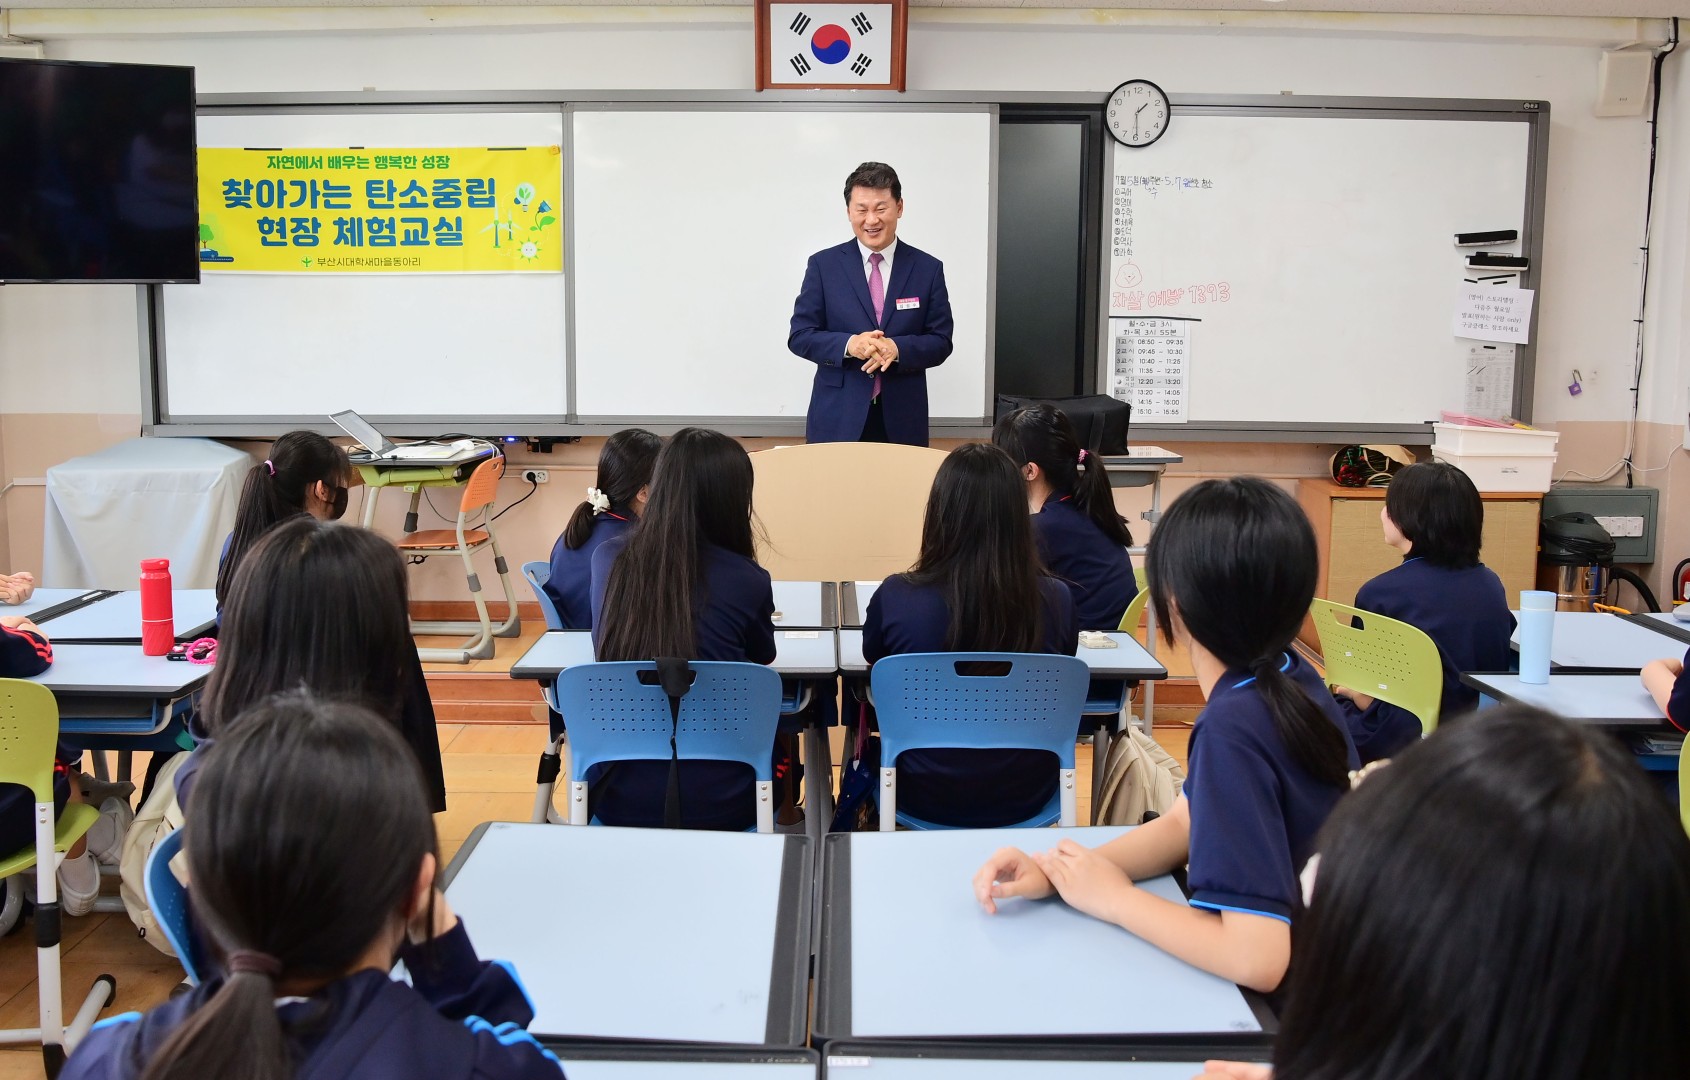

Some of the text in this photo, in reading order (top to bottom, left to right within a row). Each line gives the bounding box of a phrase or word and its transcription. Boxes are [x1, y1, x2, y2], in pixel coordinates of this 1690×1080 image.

[1134, 86, 1143, 94] 12
[1148, 90, 1151, 98] 1
[1114, 98, 1123, 106] 10
[1155, 99, 1161, 107] 2
[1110, 110, 1116, 118] 9
[1113, 121, 1120, 129] 8
[1122, 130, 1128, 138] 7
[1144, 130, 1151, 138] 5
[267, 155, 450, 170] 자연에서 배우는 행복한 성장
[221, 177, 496, 210] 찾아가는 탄소중립
[256, 216, 464, 248] 현장 체험교실
[316, 256, 421, 268] 부산시대학새마을동아리
[1112, 281, 1230, 311] 자살 예방 1393
